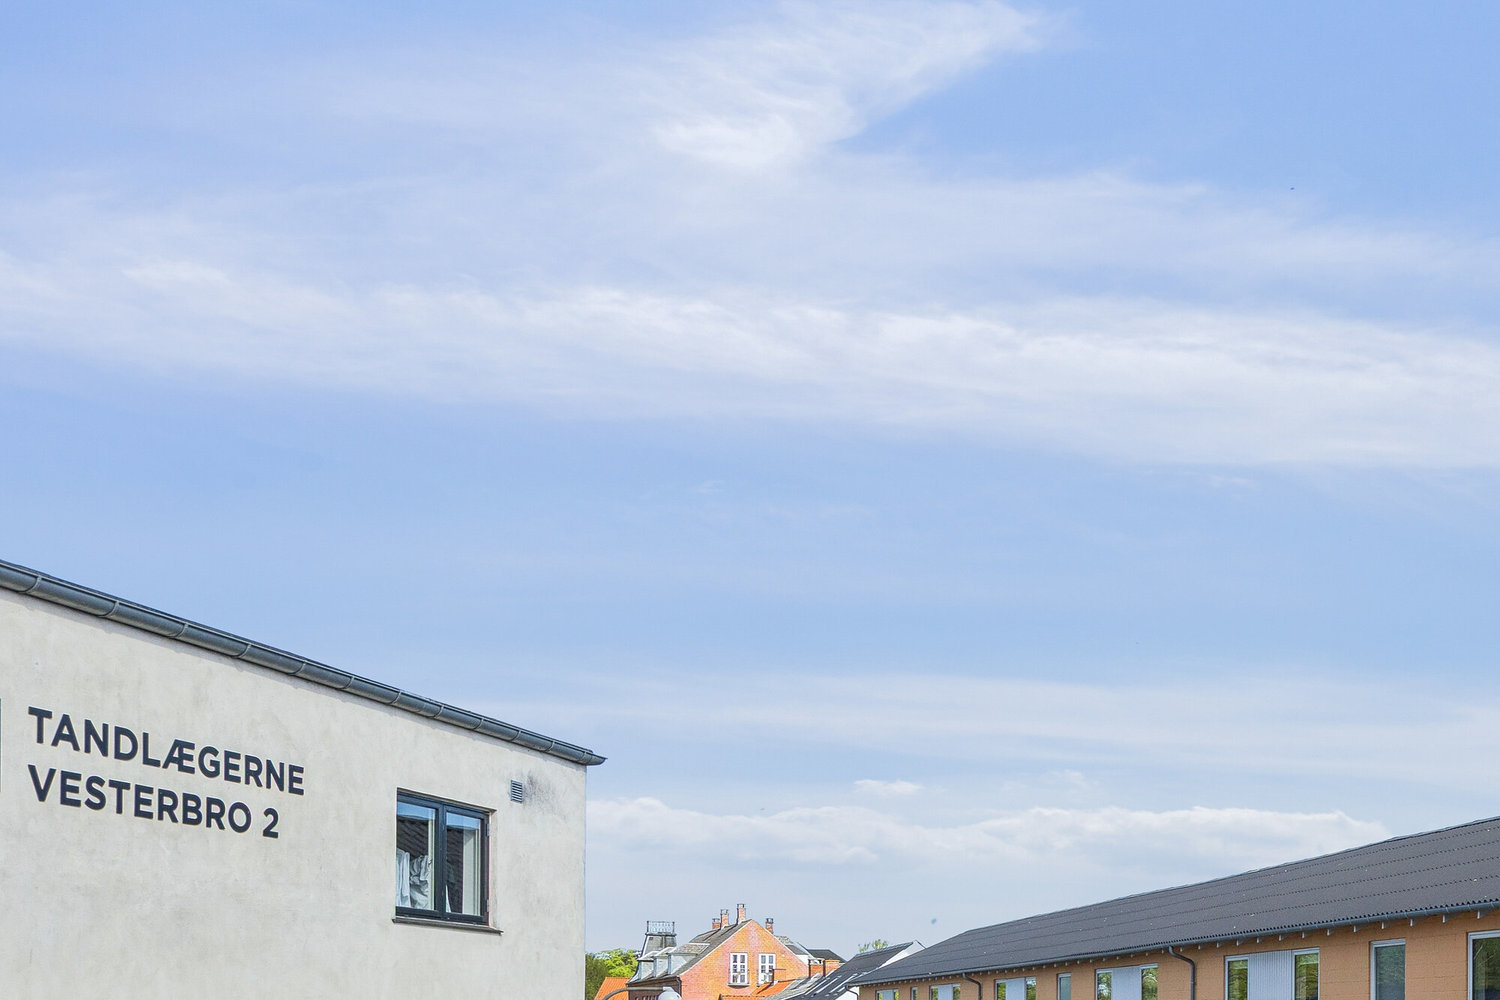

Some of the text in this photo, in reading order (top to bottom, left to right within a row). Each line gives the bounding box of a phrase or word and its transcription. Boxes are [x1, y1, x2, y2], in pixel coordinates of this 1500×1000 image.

[27, 705, 305, 796] TANDLÆGERNE
[27, 764, 279, 839] VESTERBRO 2
